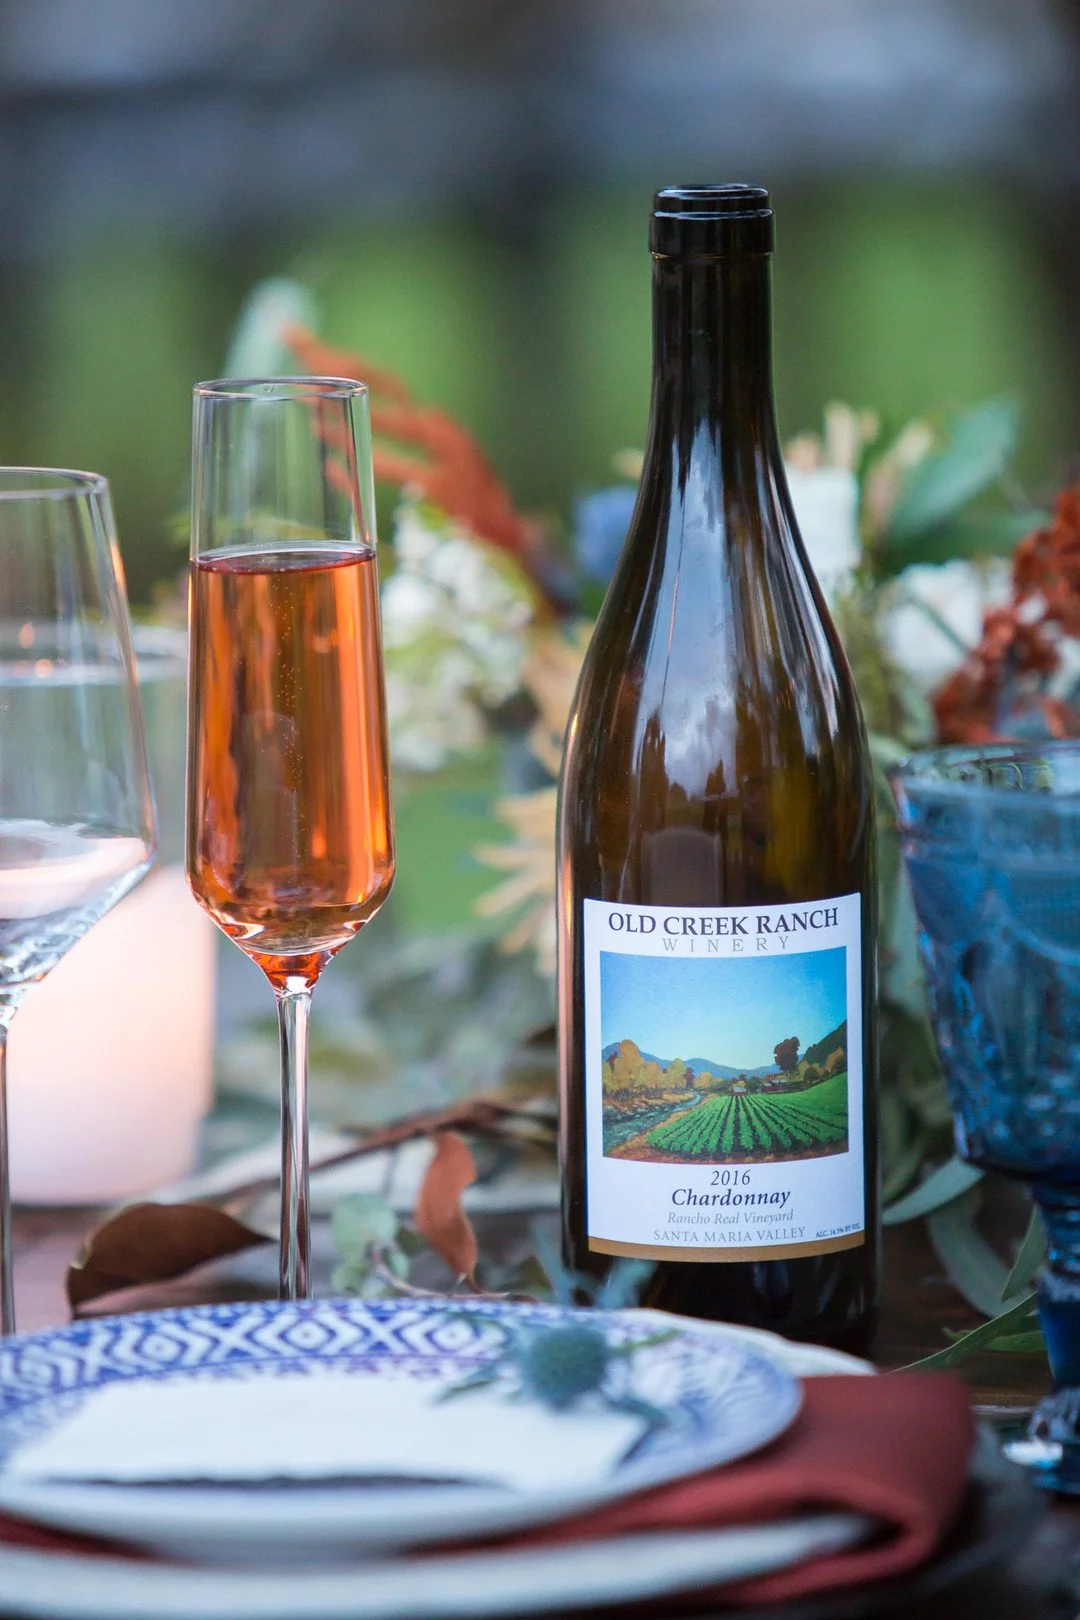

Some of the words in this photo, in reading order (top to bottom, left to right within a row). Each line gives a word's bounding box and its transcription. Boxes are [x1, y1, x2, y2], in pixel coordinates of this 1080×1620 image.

[608, 912, 657, 934] OLD
[663, 916, 749, 936] CREEK
[755, 907, 839, 934] RANCH
[662, 935, 789, 953] WINERY
[710, 1169, 751, 1186] 2016
[671, 1188, 791, 1208] Chardonnay
[667, 1211, 711, 1225] Rancho
[714, 1212, 739, 1225] Real
[744, 1209, 794, 1225] Vineyard
[653, 1229, 699, 1242] SANTA
[704, 1230, 752, 1243] MARIA
[757, 1226, 806, 1241] VALLEY
